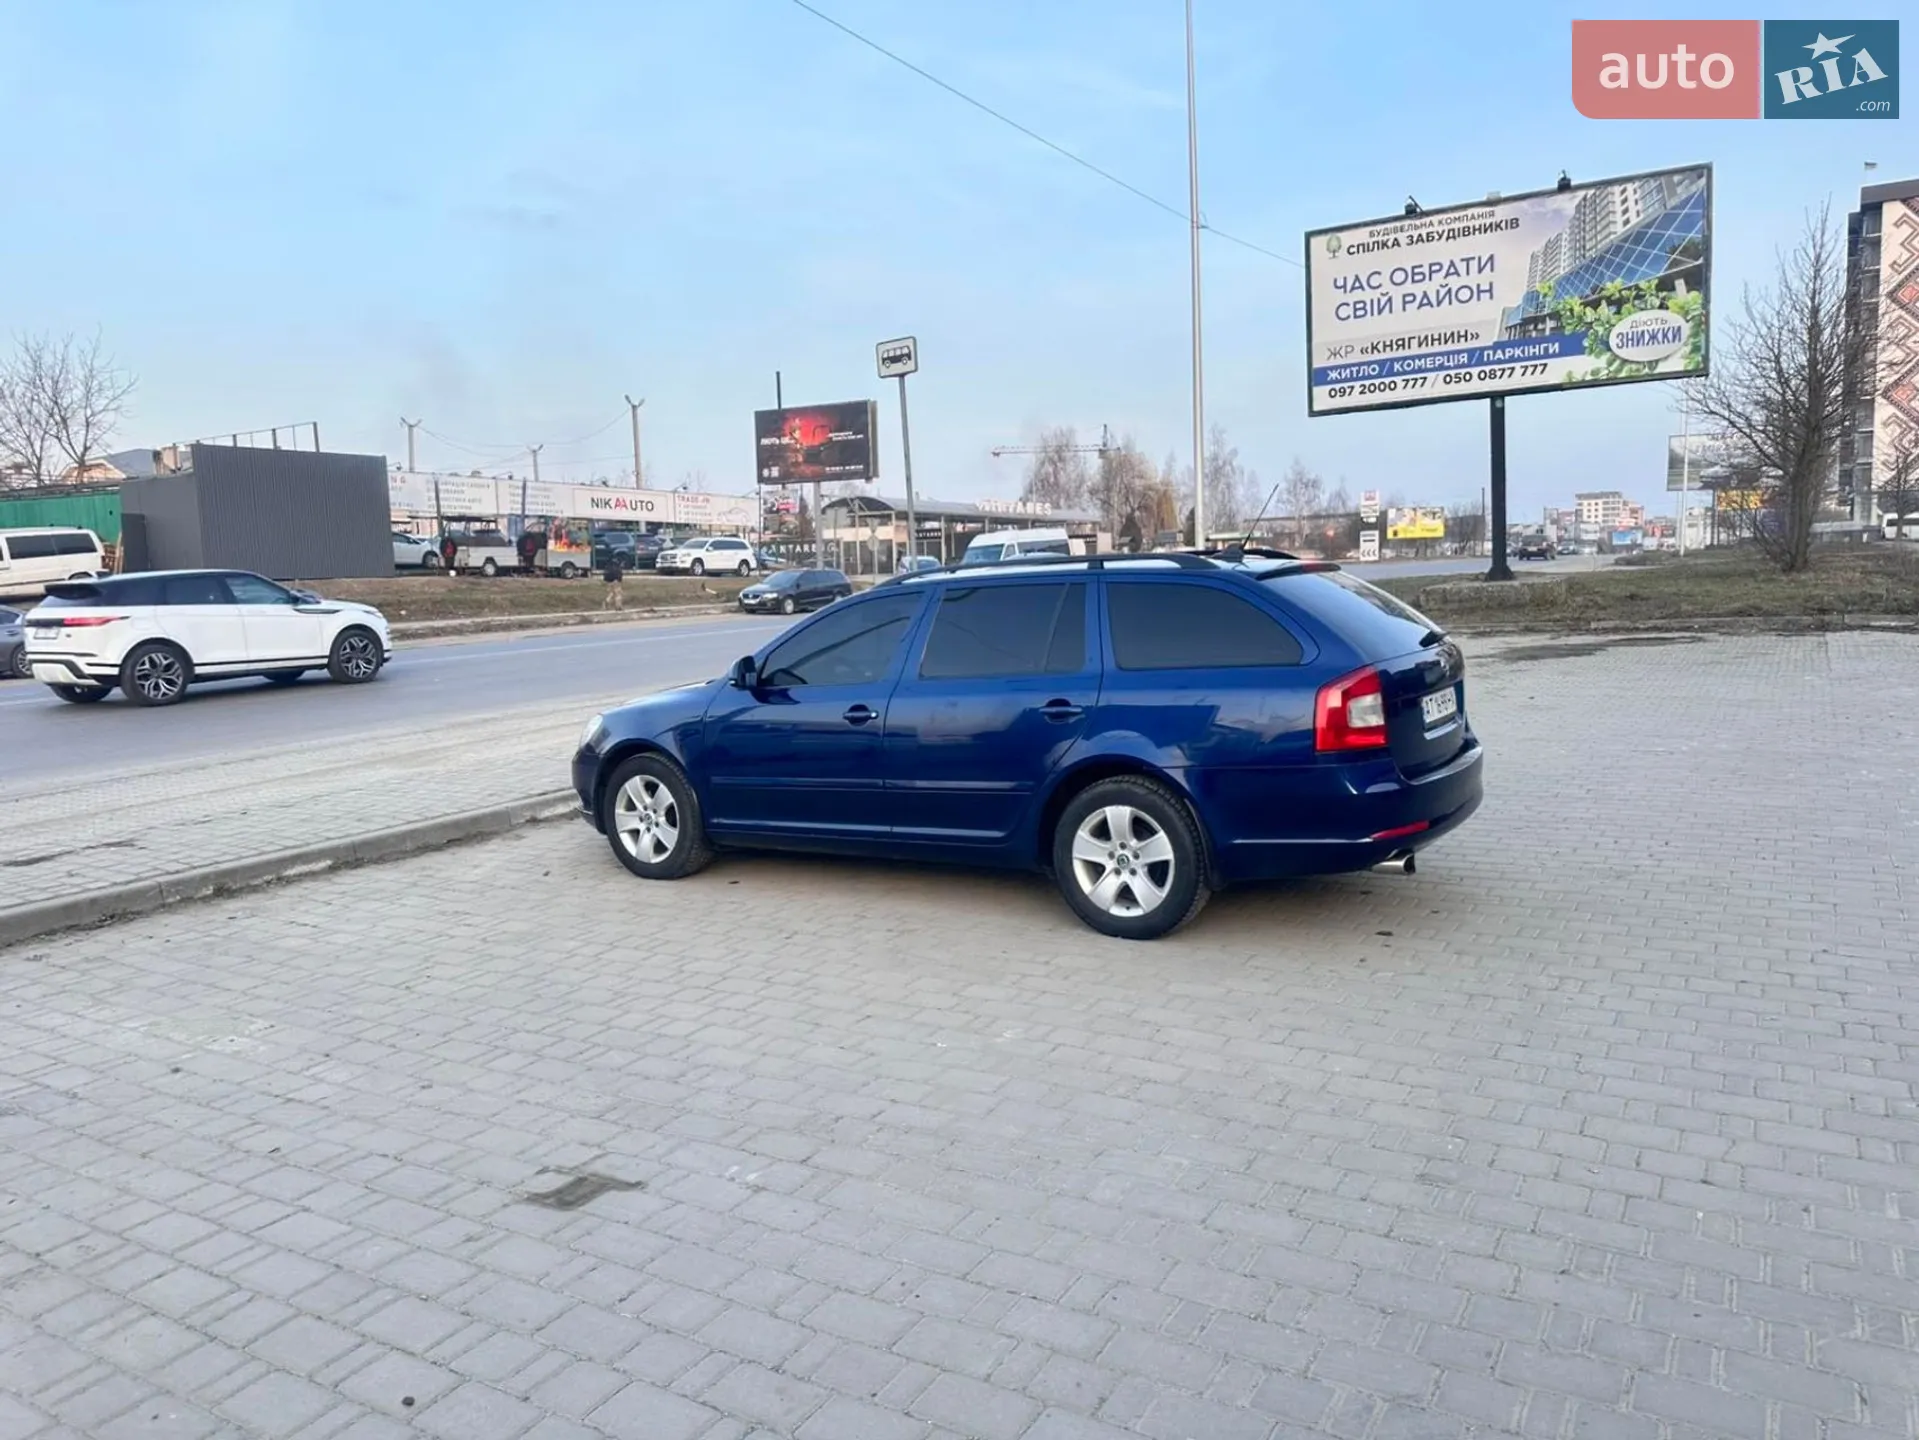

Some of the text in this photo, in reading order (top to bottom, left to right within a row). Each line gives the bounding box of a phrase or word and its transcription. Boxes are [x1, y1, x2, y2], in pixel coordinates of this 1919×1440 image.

[1347, 217, 1520, 256] СПІЛКА ЗАБУДІВНИКІВ
[1369, 210, 1496, 238] БУДІВЕЛЬНА КОМПАНІЯ
[1333, 254, 1495, 295] ЧАС ОБРАТИ
[1335, 282, 1494, 321] СВІЙ РАЙОН
[1616, 325, 1682, 349] ЗНИЖКИ
[1630, 317, 1668, 330] ДІЮТЬ
[1326, 329, 1480, 361] ЖР «КНЯГИНИН»
[1326, 363, 1379, 381] ЖИТЛО
[1393, 354, 1468, 373] КОМЕРЦІЯ
[1483, 342, 1560, 361] ПАРКІНГИ
[1328, 385, 1355, 398] 097
[1358, 380, 1398, 396] 2000
[1402, 376, 1428, 391] 777
[1443, 371, 1473, 385] 050
[1477, 366, 1516, 382] 0877
[1520, 363, 1549, 378] 777
